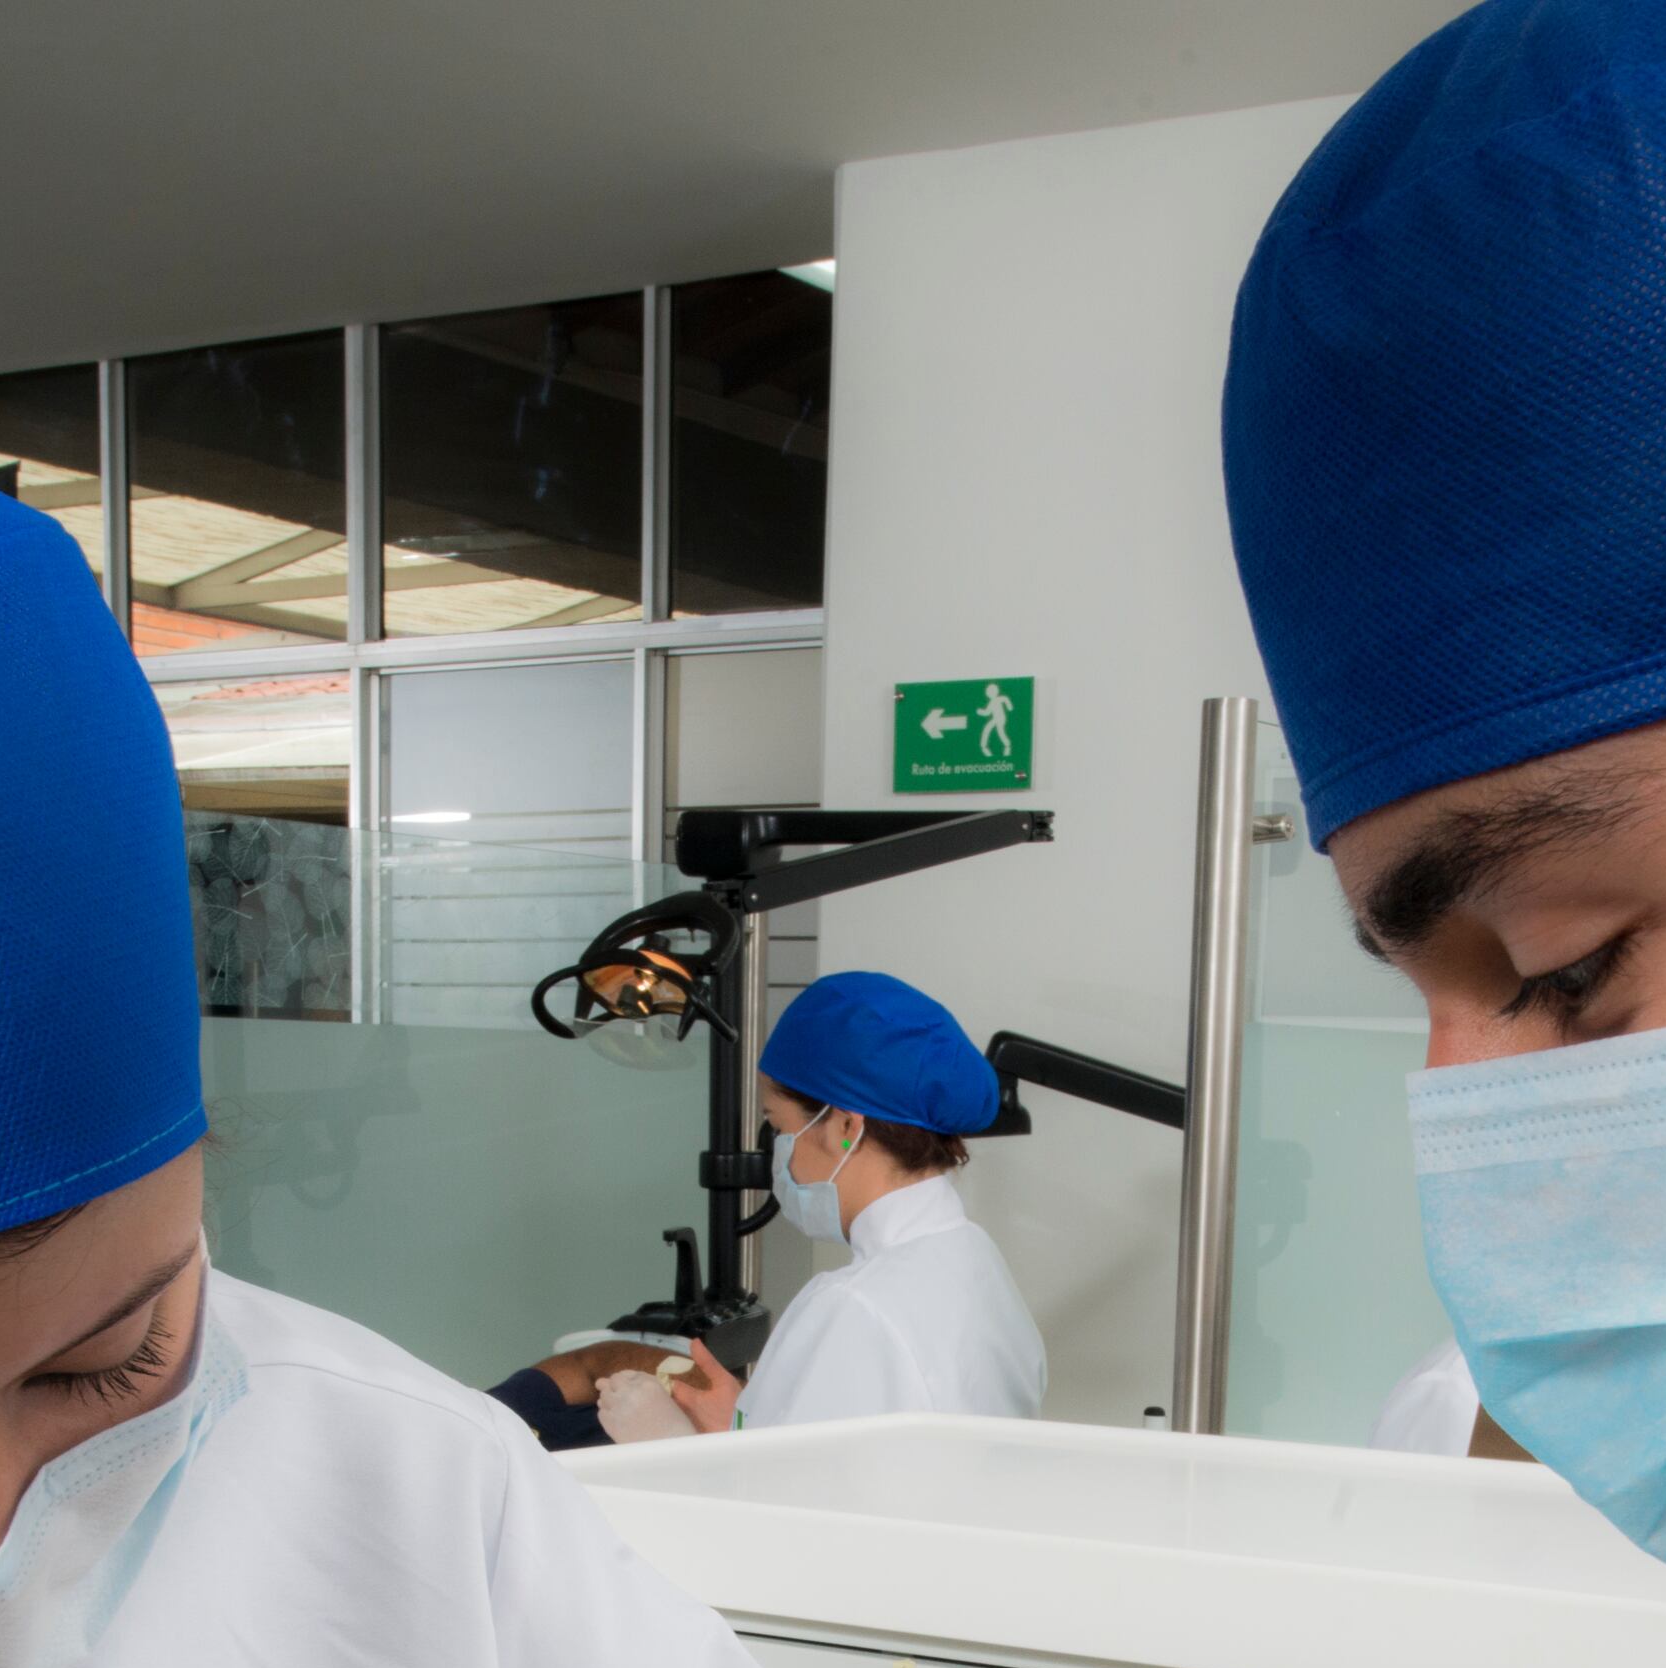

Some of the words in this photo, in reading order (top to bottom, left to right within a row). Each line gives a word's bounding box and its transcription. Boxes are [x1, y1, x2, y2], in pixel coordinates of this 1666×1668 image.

[911, 762, 936, 775] Ruta
[938, 761, 952, 775] de
[954, 760, 1015, 774] evacuación
